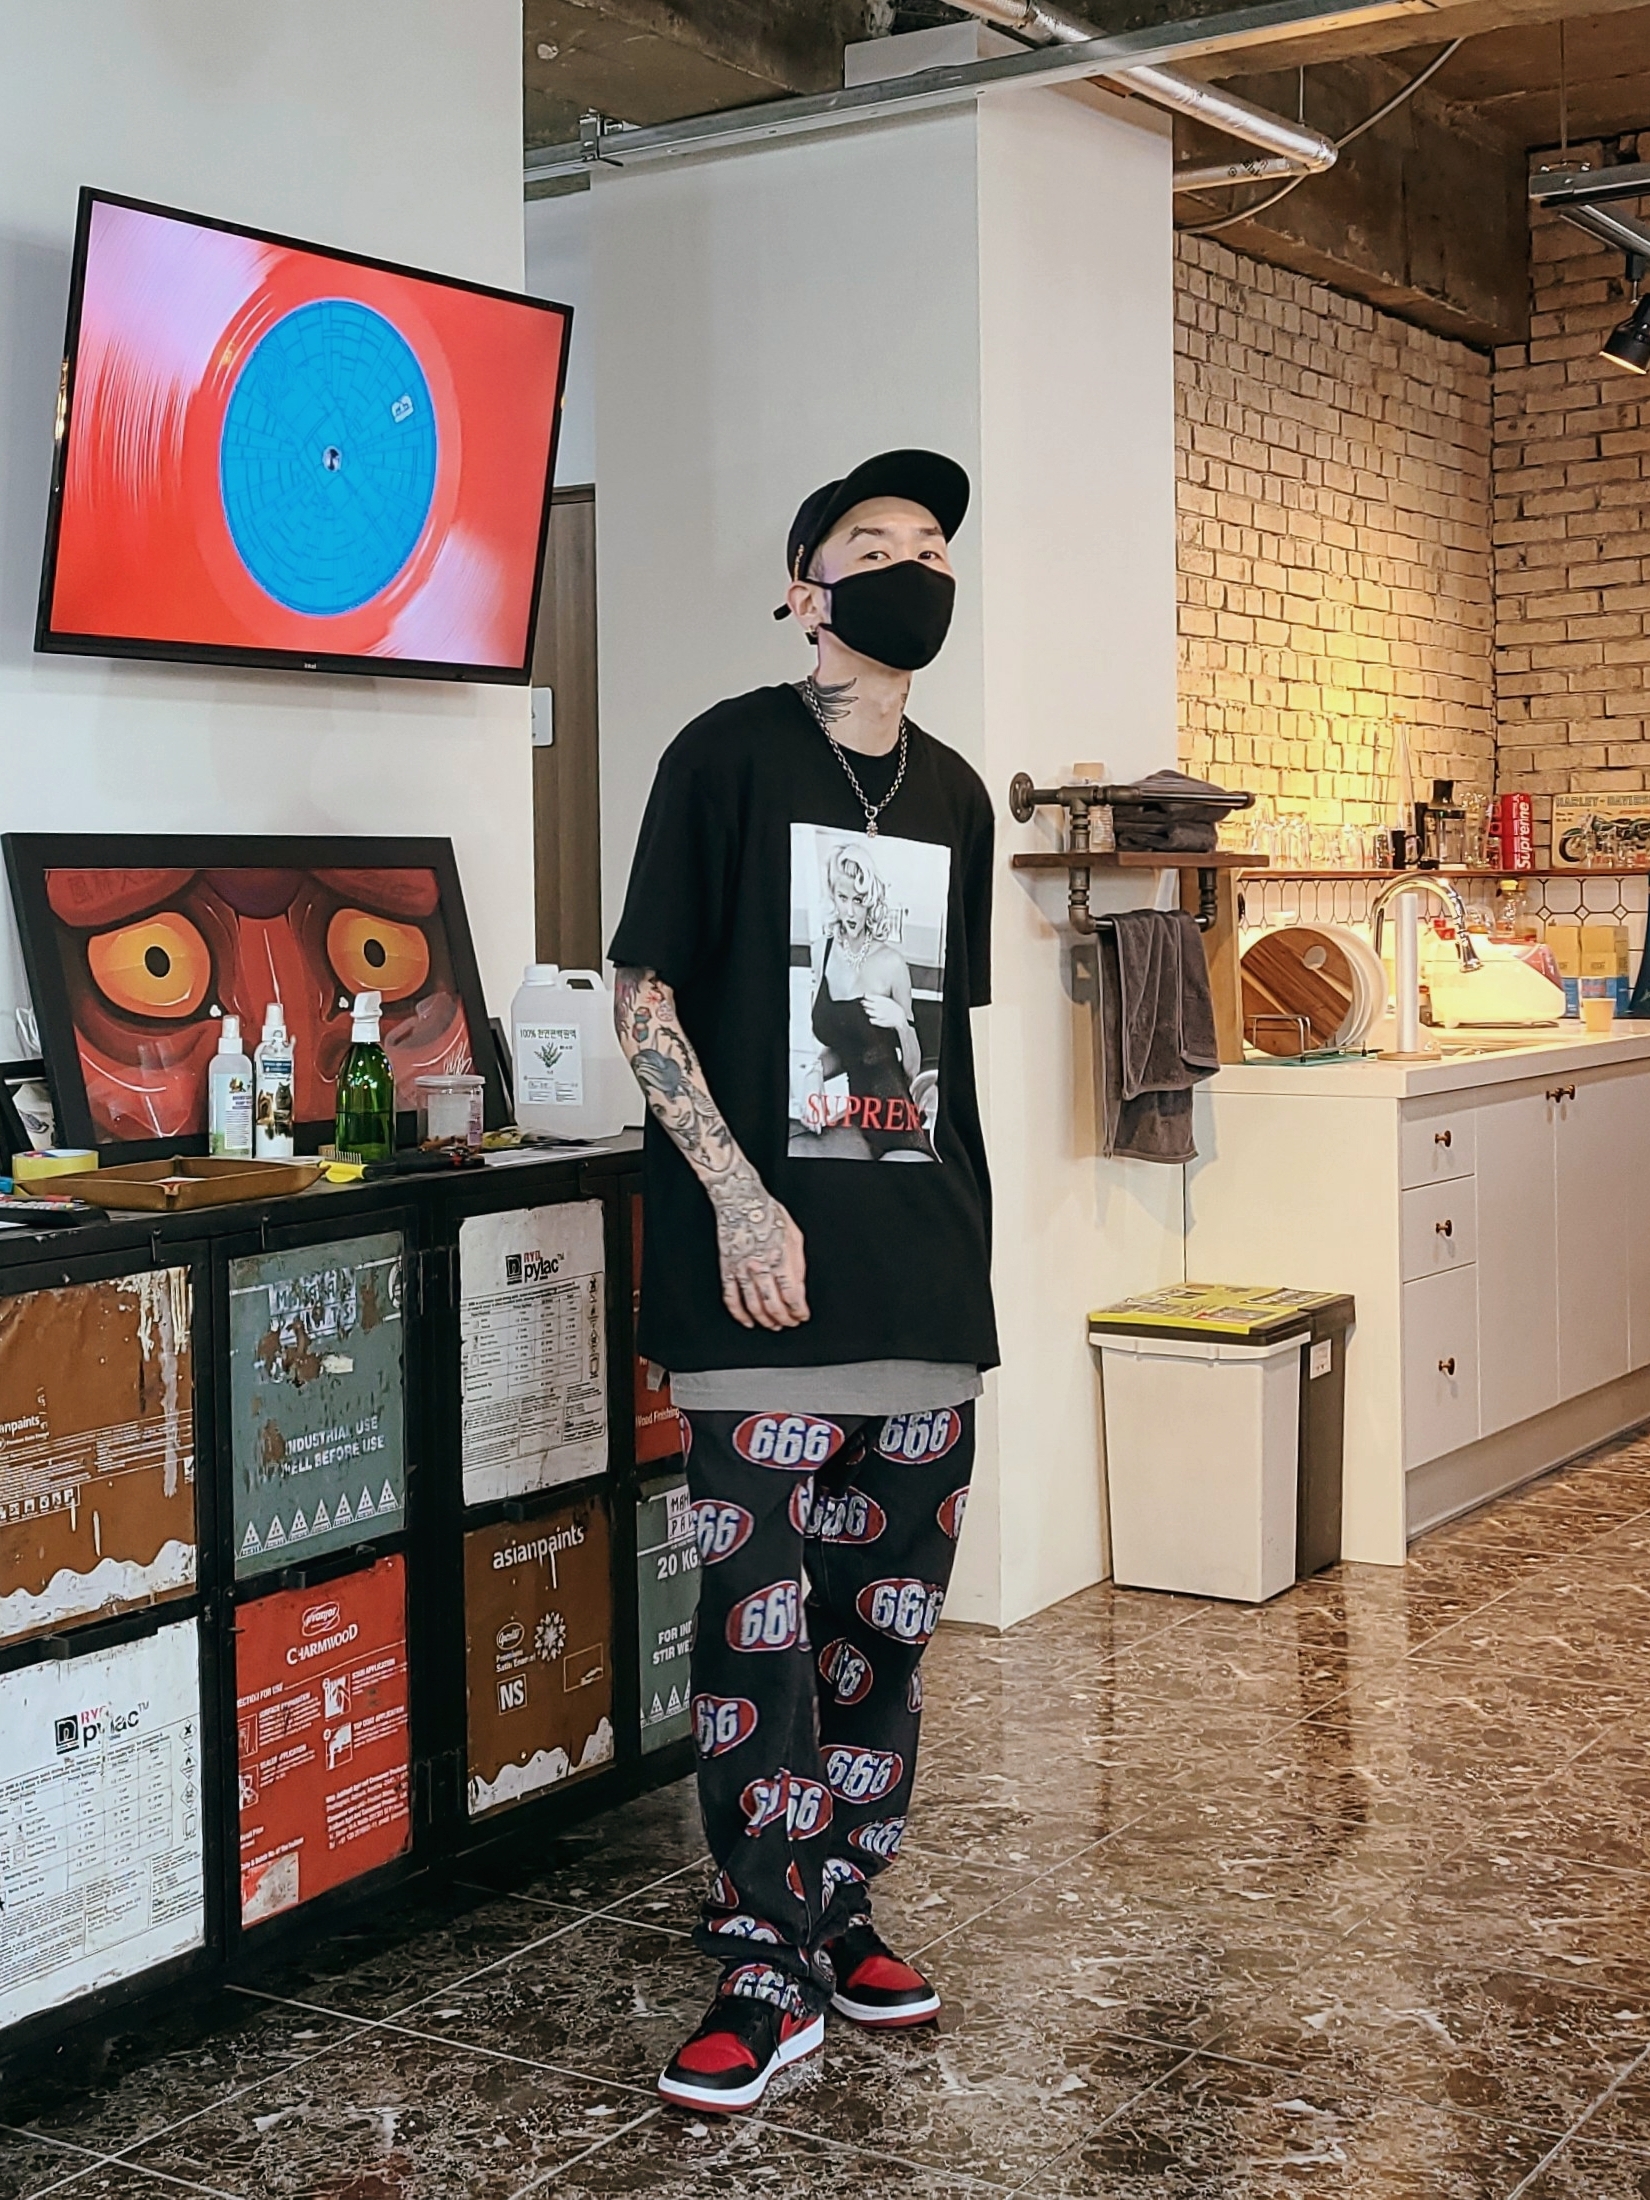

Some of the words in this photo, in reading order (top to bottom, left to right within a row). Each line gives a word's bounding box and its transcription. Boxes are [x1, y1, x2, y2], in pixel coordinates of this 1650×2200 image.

[520, 1029, 536, 1039] 100%
[525, 1257, 559, 1283] pylac
[355, 1414, 378, 1435] USE
[314, 1441, 360, 1468] BEFORE
[361, 1434, 386, 1453] USE
[748, 1416, 832, 1465] 666
[492, 1525, 585, 1570] asianpaints
[657, 1553, 678, 1580] 20
[657, 1626, 678, 1645] FOR
[652, 1644, 675, 1666] STIR
[500, 1679, 524, 1711] NS
